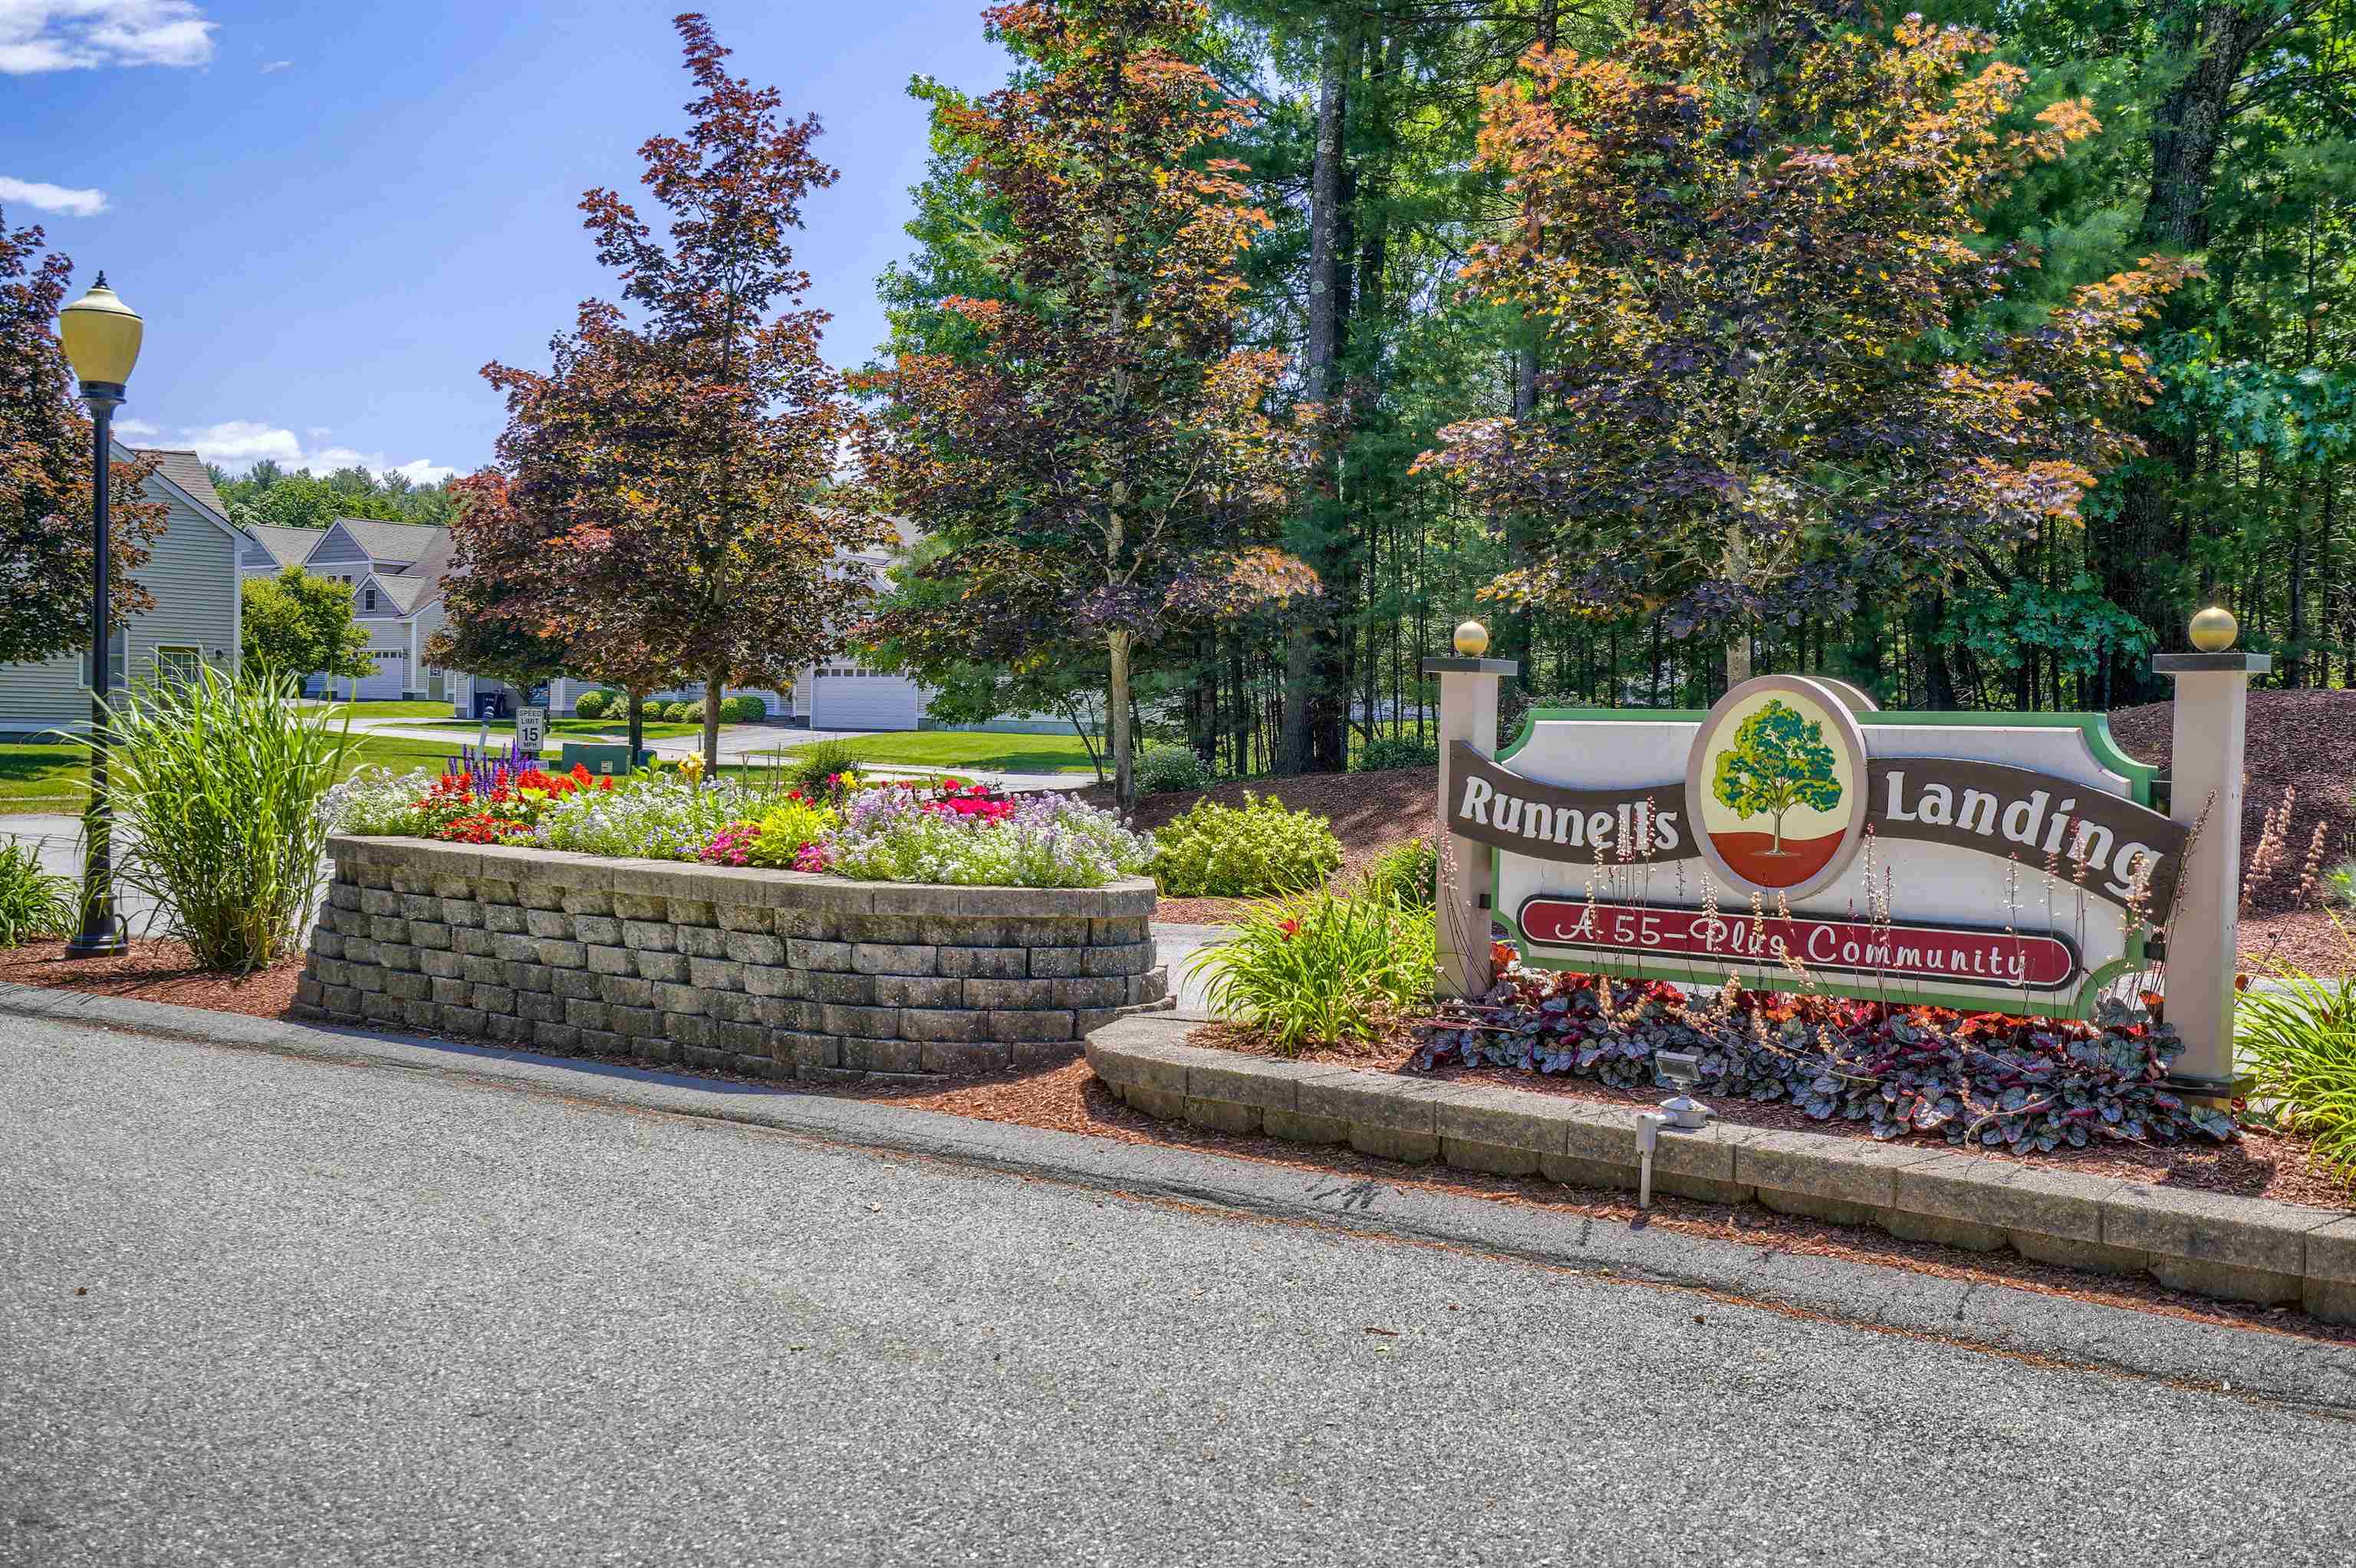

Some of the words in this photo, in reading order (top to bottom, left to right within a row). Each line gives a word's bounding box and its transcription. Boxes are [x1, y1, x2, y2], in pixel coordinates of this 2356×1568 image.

[522, 728, 538, 741] 15
[1459, 775, 1680, 850] Runnells
[1885, 771, 2164, 901] Landing
[1555, 907, 1594, 940] A
[1807, 925, 2025, 987] Community
